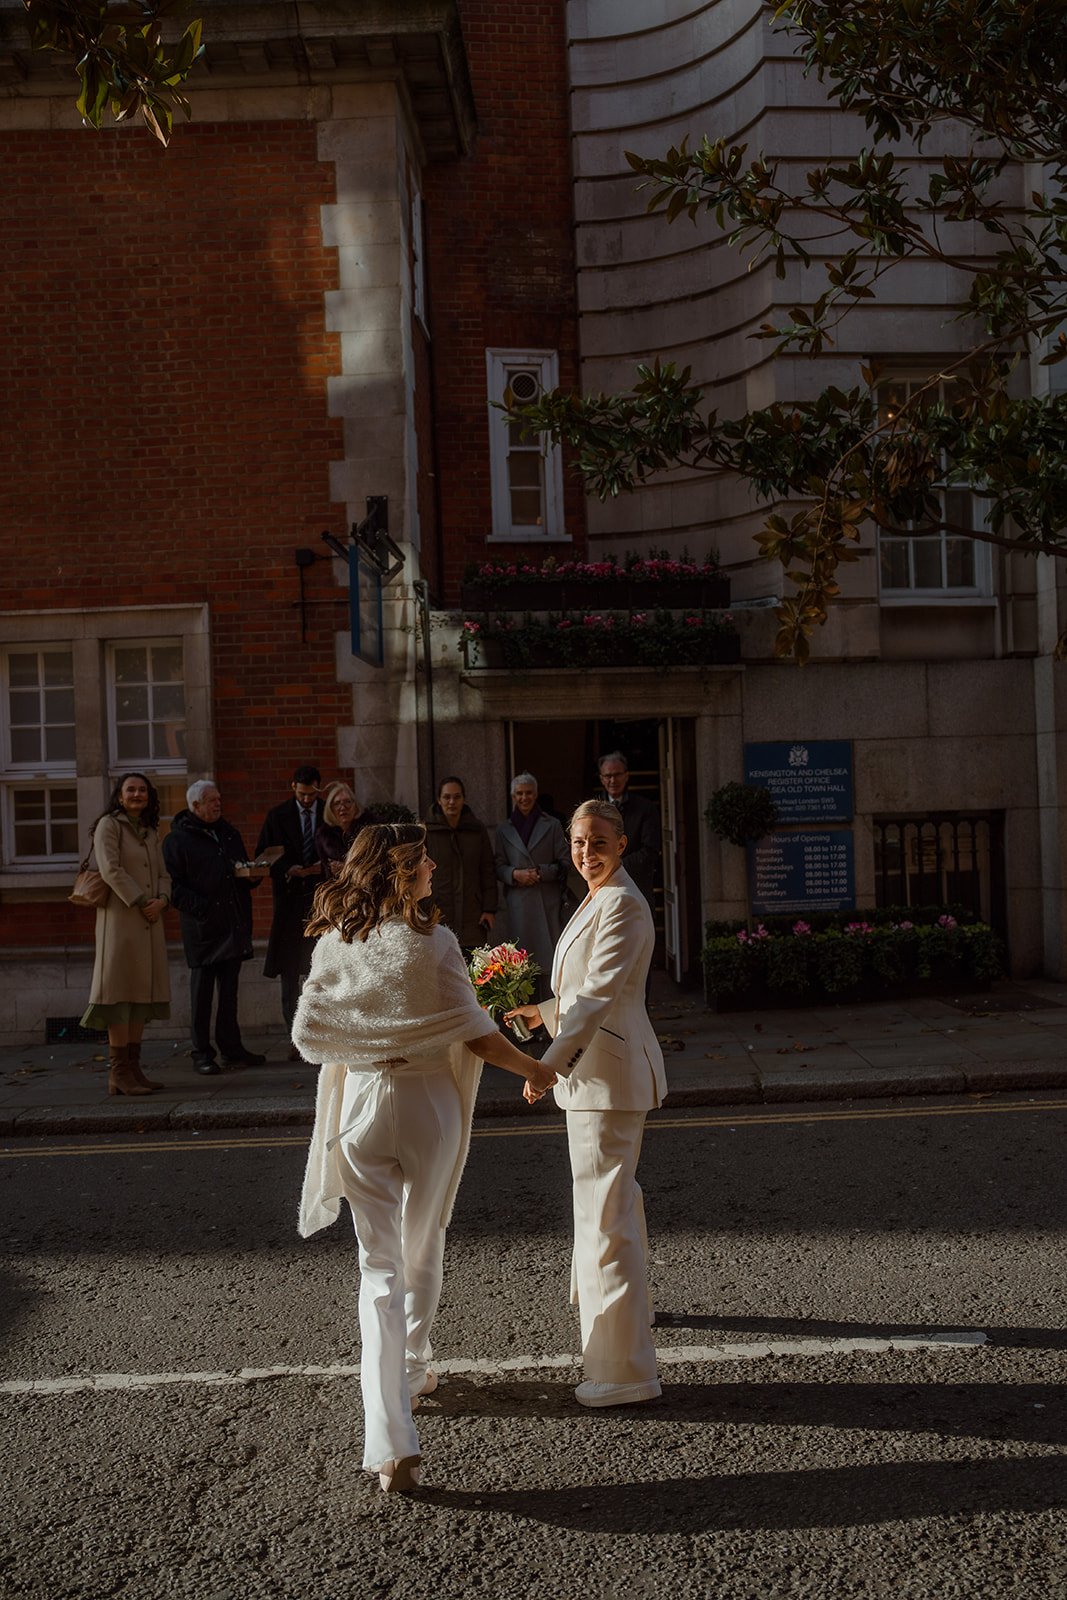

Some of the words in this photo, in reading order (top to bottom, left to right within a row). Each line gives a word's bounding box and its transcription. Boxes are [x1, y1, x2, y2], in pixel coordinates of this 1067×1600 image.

[749, 769, 797, 778] KENSINGTON
[798, 769, 813, 777] AND
[814, 768, 848, 776] CHELSEA
[787, 785, 803, 793] OLD
[827, 784, 846, 792] HALL
[771, 835, 791, 843] Hours
[800, 835, 831, 844] Opening
[757, 881, 778, 889] Fridays
